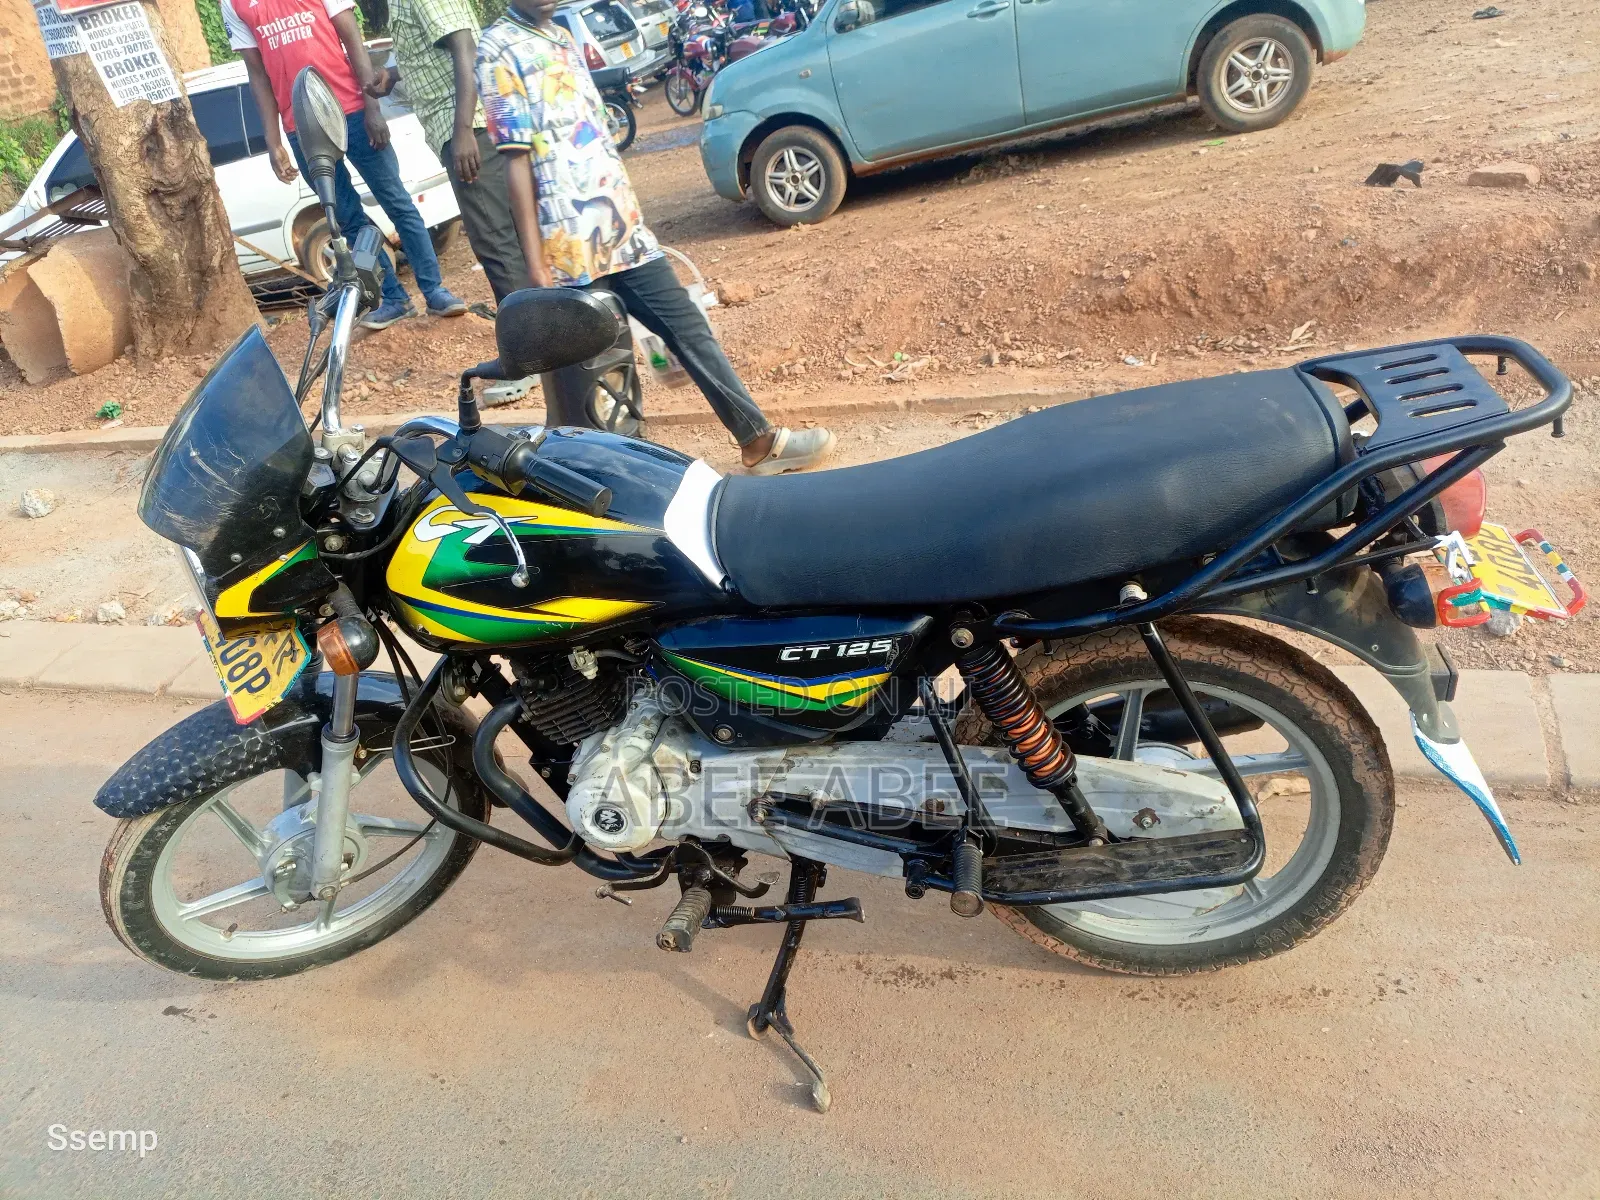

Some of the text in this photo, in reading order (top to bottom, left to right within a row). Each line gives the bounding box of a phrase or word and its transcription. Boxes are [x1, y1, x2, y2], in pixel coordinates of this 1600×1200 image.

[78, 4, 142, 31] BROKER
[87, 26, 117, 40] HOUSES
[125, 20, 145, 31] PLOTS
[90, 30, 150, 52] 0704-029399
[267, 25, 313, 51] FLY BETTER
[103, 52, 160, 79] BROKER
[111, 75, 139, 89] HOUSES
[146, 67, 167, 79] PLOTS
[780, 639, 893, 661] CT 125
